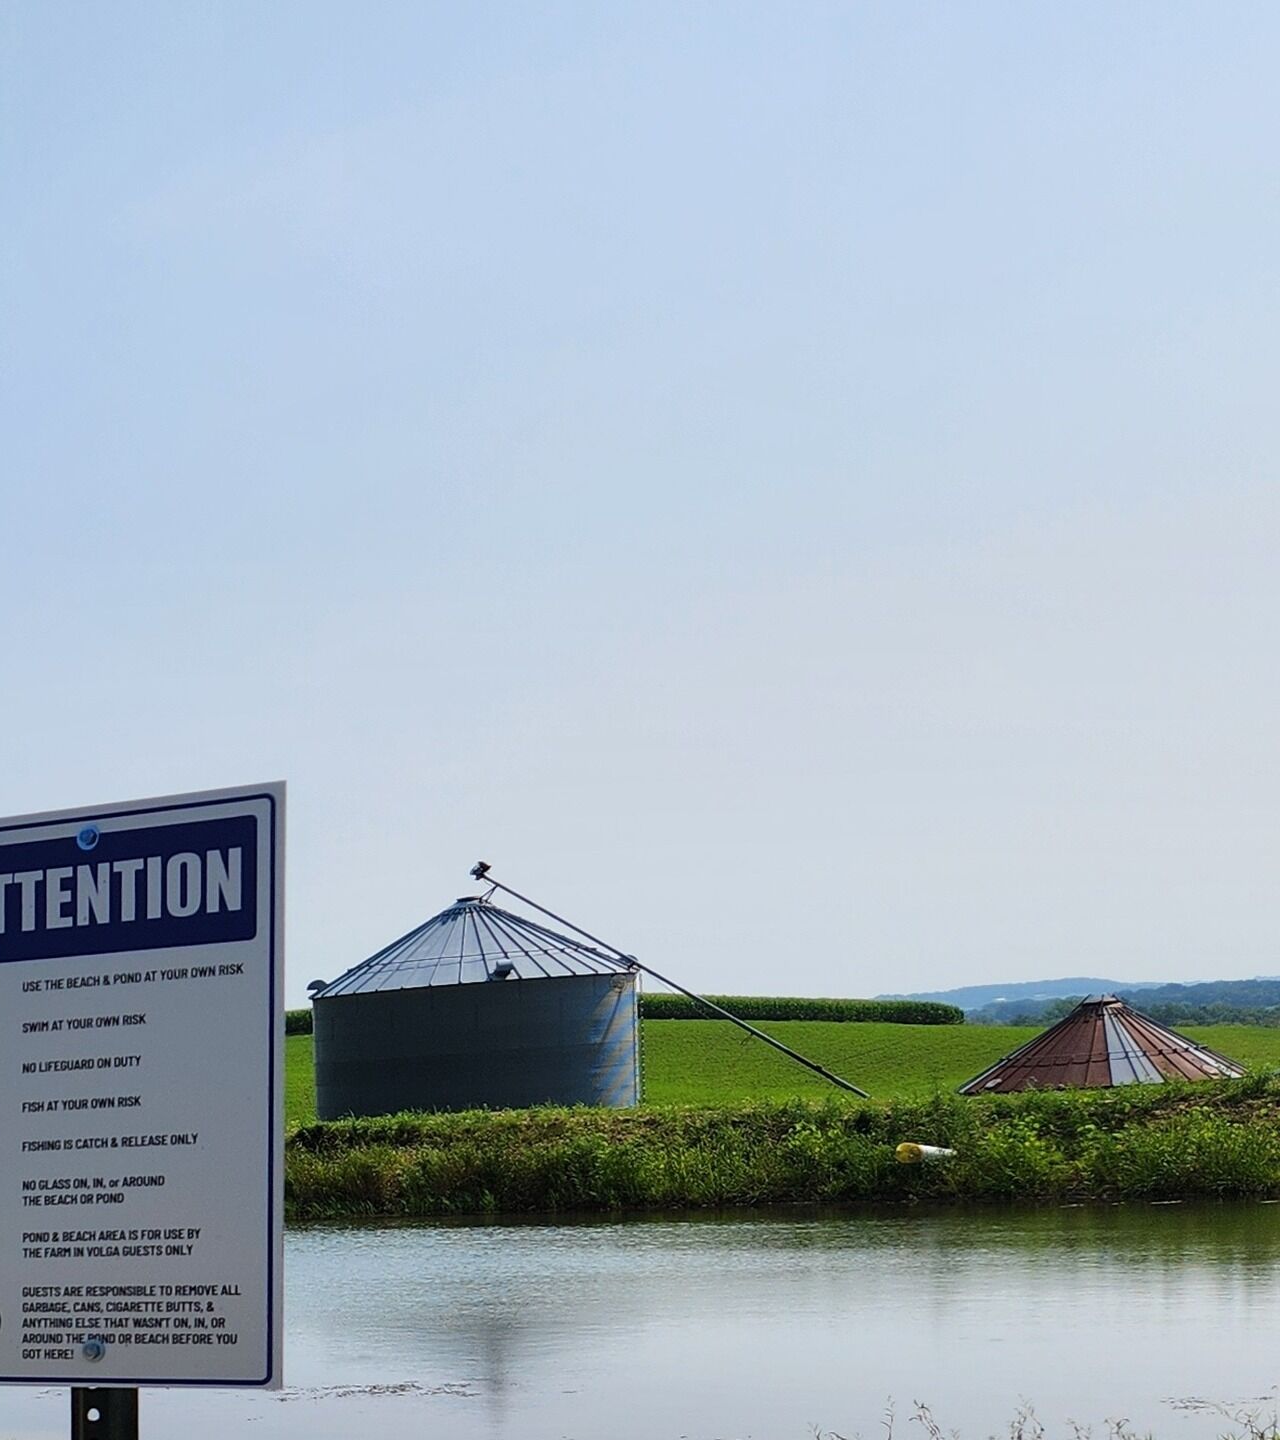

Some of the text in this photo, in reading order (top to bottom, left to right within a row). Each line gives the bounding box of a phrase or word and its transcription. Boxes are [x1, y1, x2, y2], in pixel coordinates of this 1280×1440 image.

[23, 963, 243, 992] USE THE BEACH & POND AT YOUR OWN RISK
[23, 1014, 146, 1033] SWIM AT YOUR OWN RISK
[22, 1056, 141, 1074] NO LIFEGUARD ON DUTY
[22, 1096, 141, 1112] FISH AT YOUR OWN RISK
[22, 1133, 198, 1152] FISHING IS CATCH & RELEASE ONLY
[23, 1176, 165, 1191] NO GLASS ON, IN, or AROUND
[22, 1193, 124, 1206] THE BEACH OR POND
[23, 1229, 201, 1243] POND & BEACH AREA IS FOR USE BY
[23, 1245, 193, 1258] THE FARM IN VOLGA GUESTS ONLY
[22, 1285, 241, 1297] GUESTS ARE RESPONSIBLE TO REMOVE ALL
[22, 1301, 214, 1313] GARBAGE, CANS, CIGARETTE BUTTS, &
[22, 1317, 225, 1329] ANYTHING ELSE THAT WASN'T ON, IN, OR
[22, 1333, 63, 1344] AROUND
[66, 1334, 85, 1344] THE
[118, 1333, 132, 1344] OR
[135, 1333, 169, 1344] BEACH
[172, 1334, 213, 1344] BEFORE
[216, 1334, 237, 1344] YOU
[22, 1349, 74, 1359] GOT HERE!
